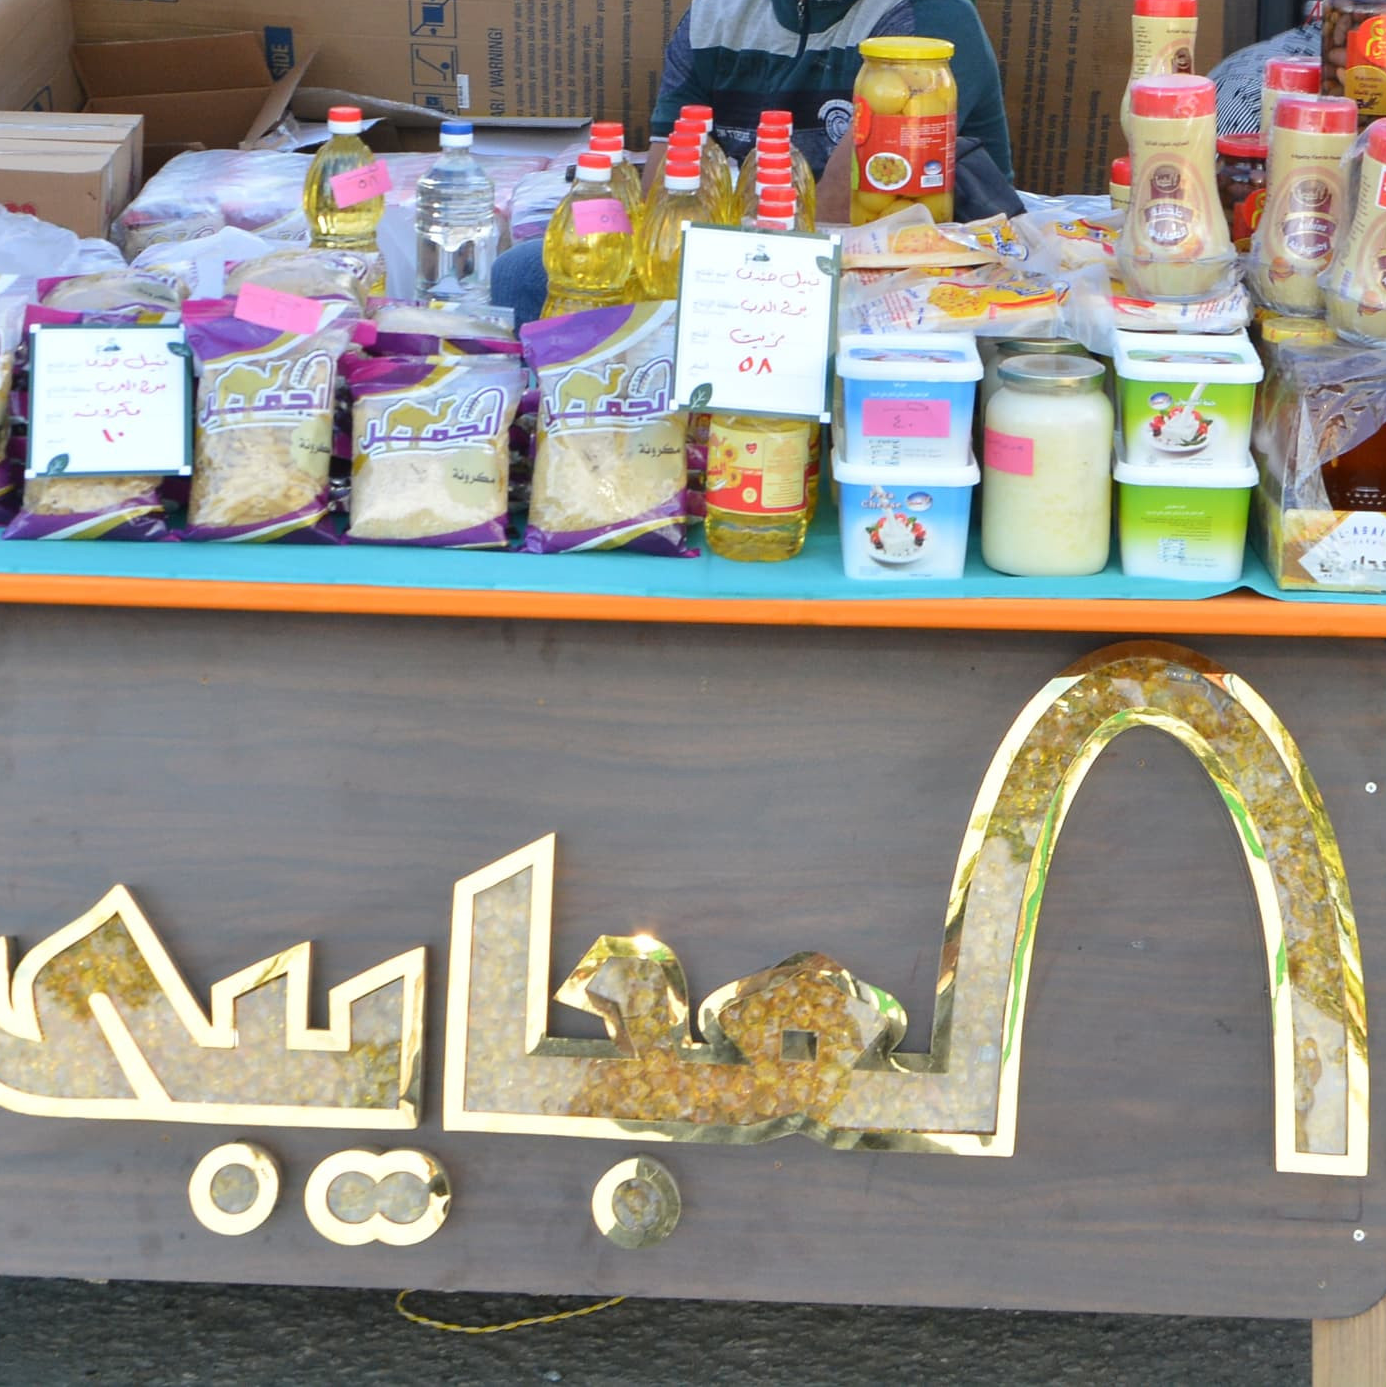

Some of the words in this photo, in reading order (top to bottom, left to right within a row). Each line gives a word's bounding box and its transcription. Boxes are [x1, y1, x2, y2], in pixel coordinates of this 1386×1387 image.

[488, 27, 503, 87] WARNING!
[637, 440, 682, 457] مكرونة
[452, 467, 496, 484] مكرونة
